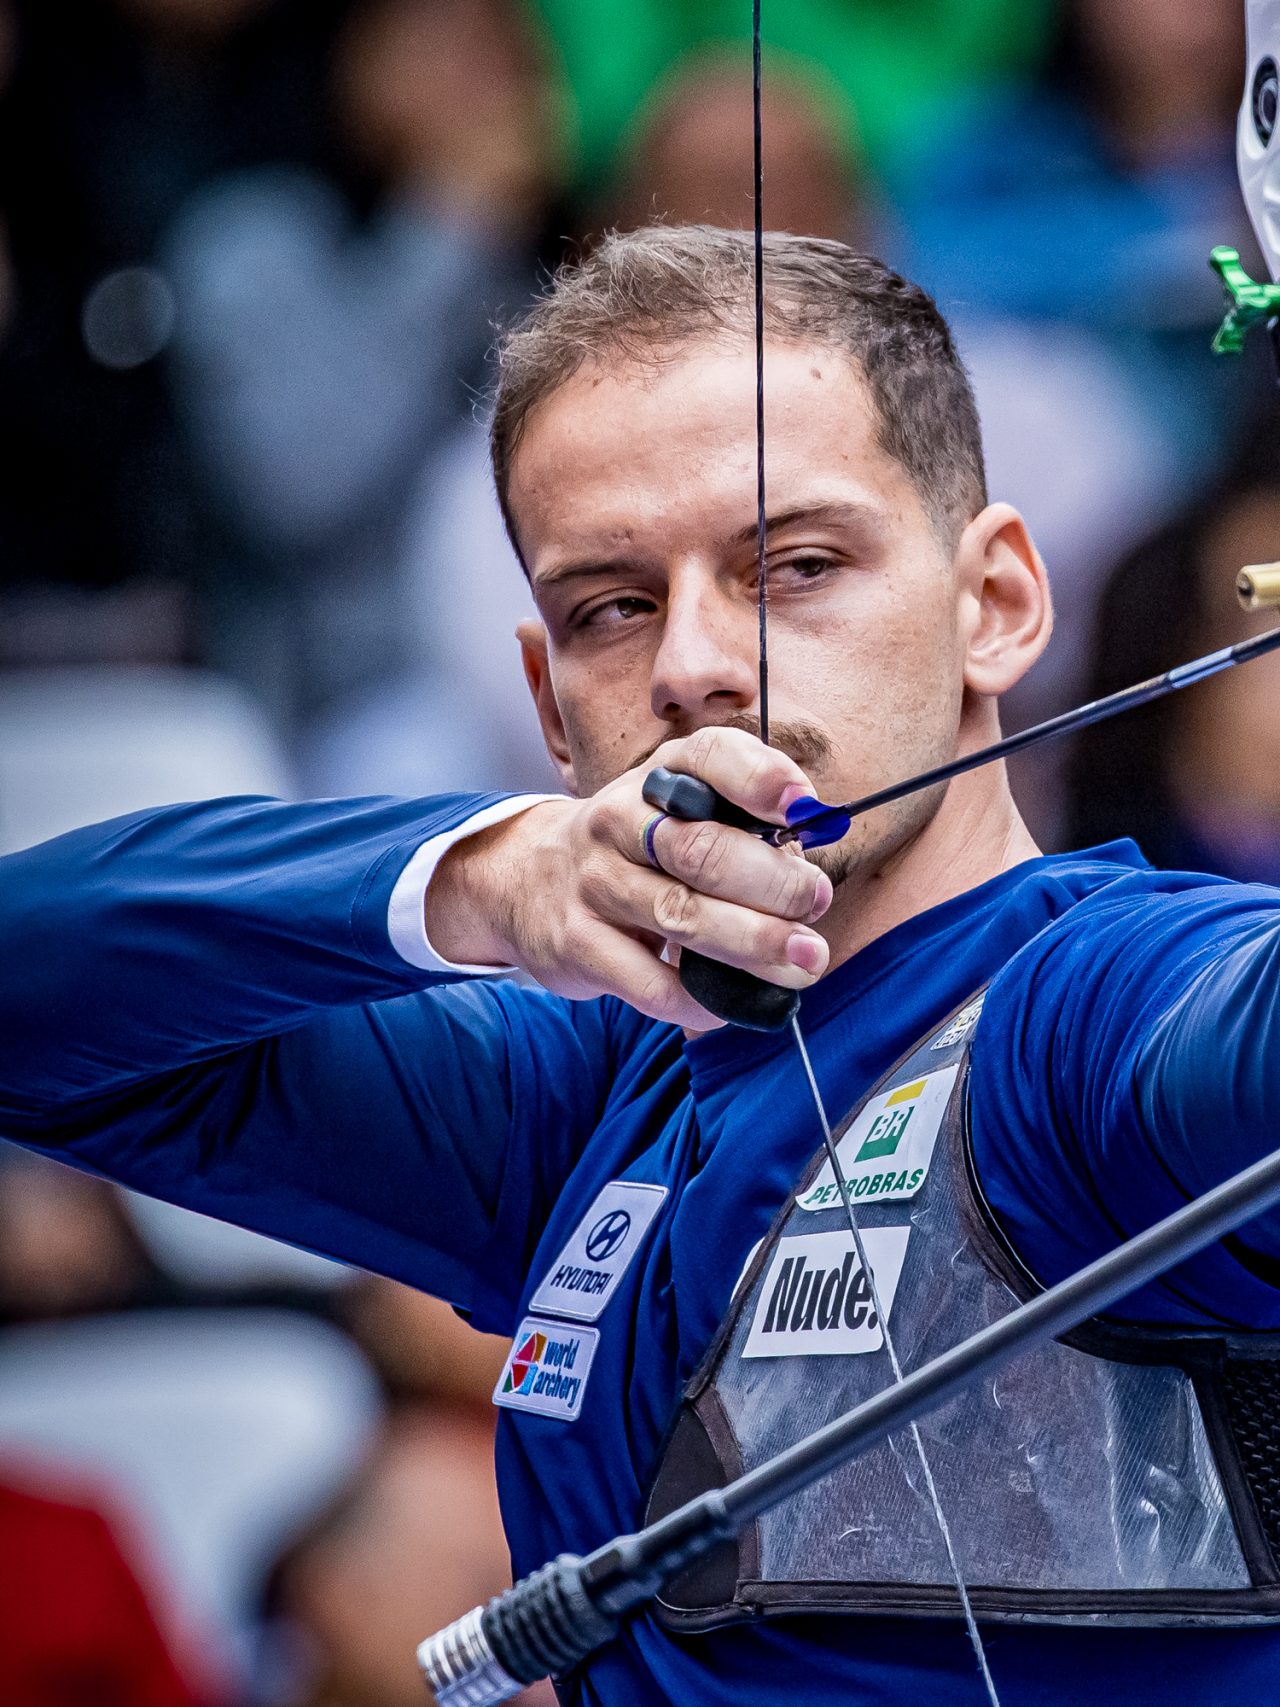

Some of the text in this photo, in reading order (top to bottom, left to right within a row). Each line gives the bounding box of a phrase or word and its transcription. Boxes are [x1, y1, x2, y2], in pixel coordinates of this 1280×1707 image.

[866, 1106, 910, 1143] BR
[551, 1265, 613, 1294] HYUNDAI
[543, 1338, 580, 1370] world
[532, 1368, 582, 1409] archery
